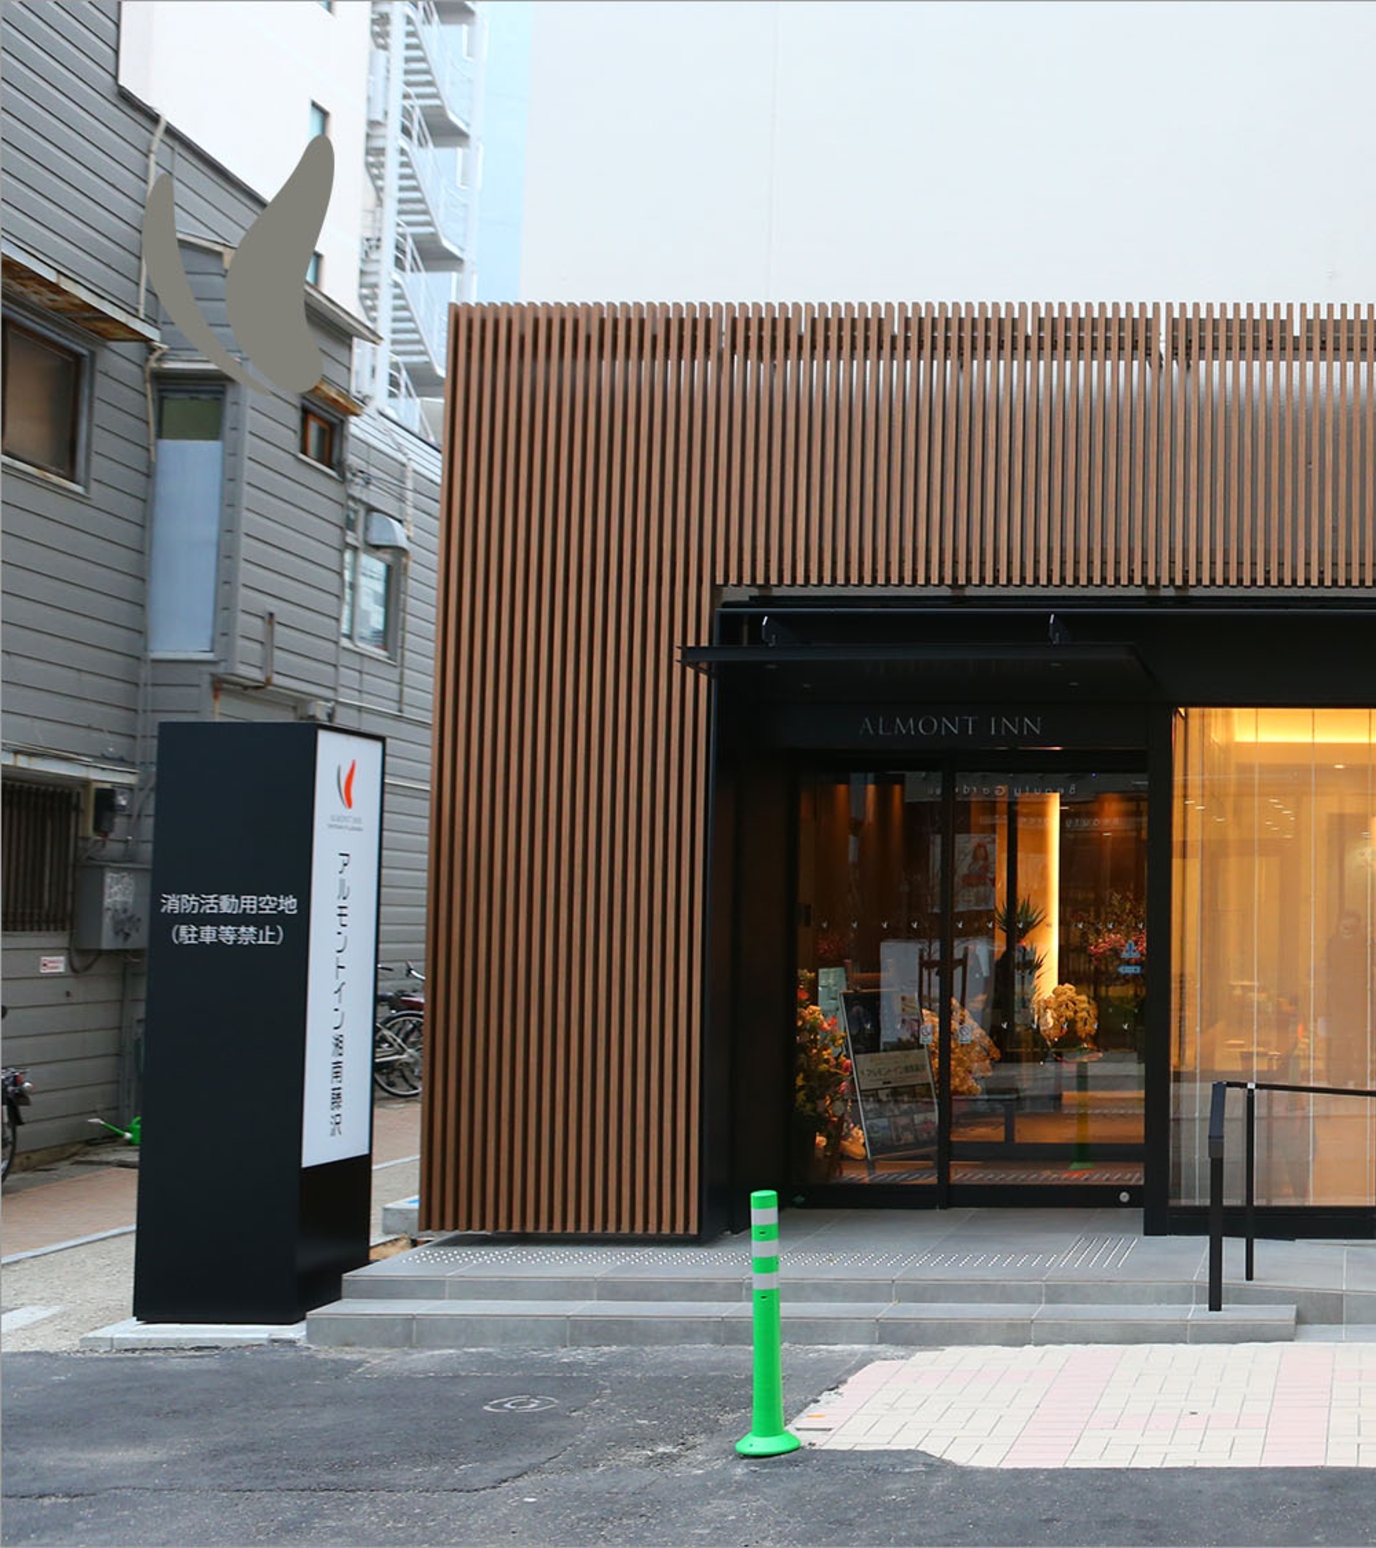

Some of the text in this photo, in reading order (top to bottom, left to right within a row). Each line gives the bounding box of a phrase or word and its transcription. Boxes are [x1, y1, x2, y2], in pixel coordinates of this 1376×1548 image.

[859, 716, 1042, 736] ALMONT INN
[160, 893, 298, 915] 消防活動用空地
